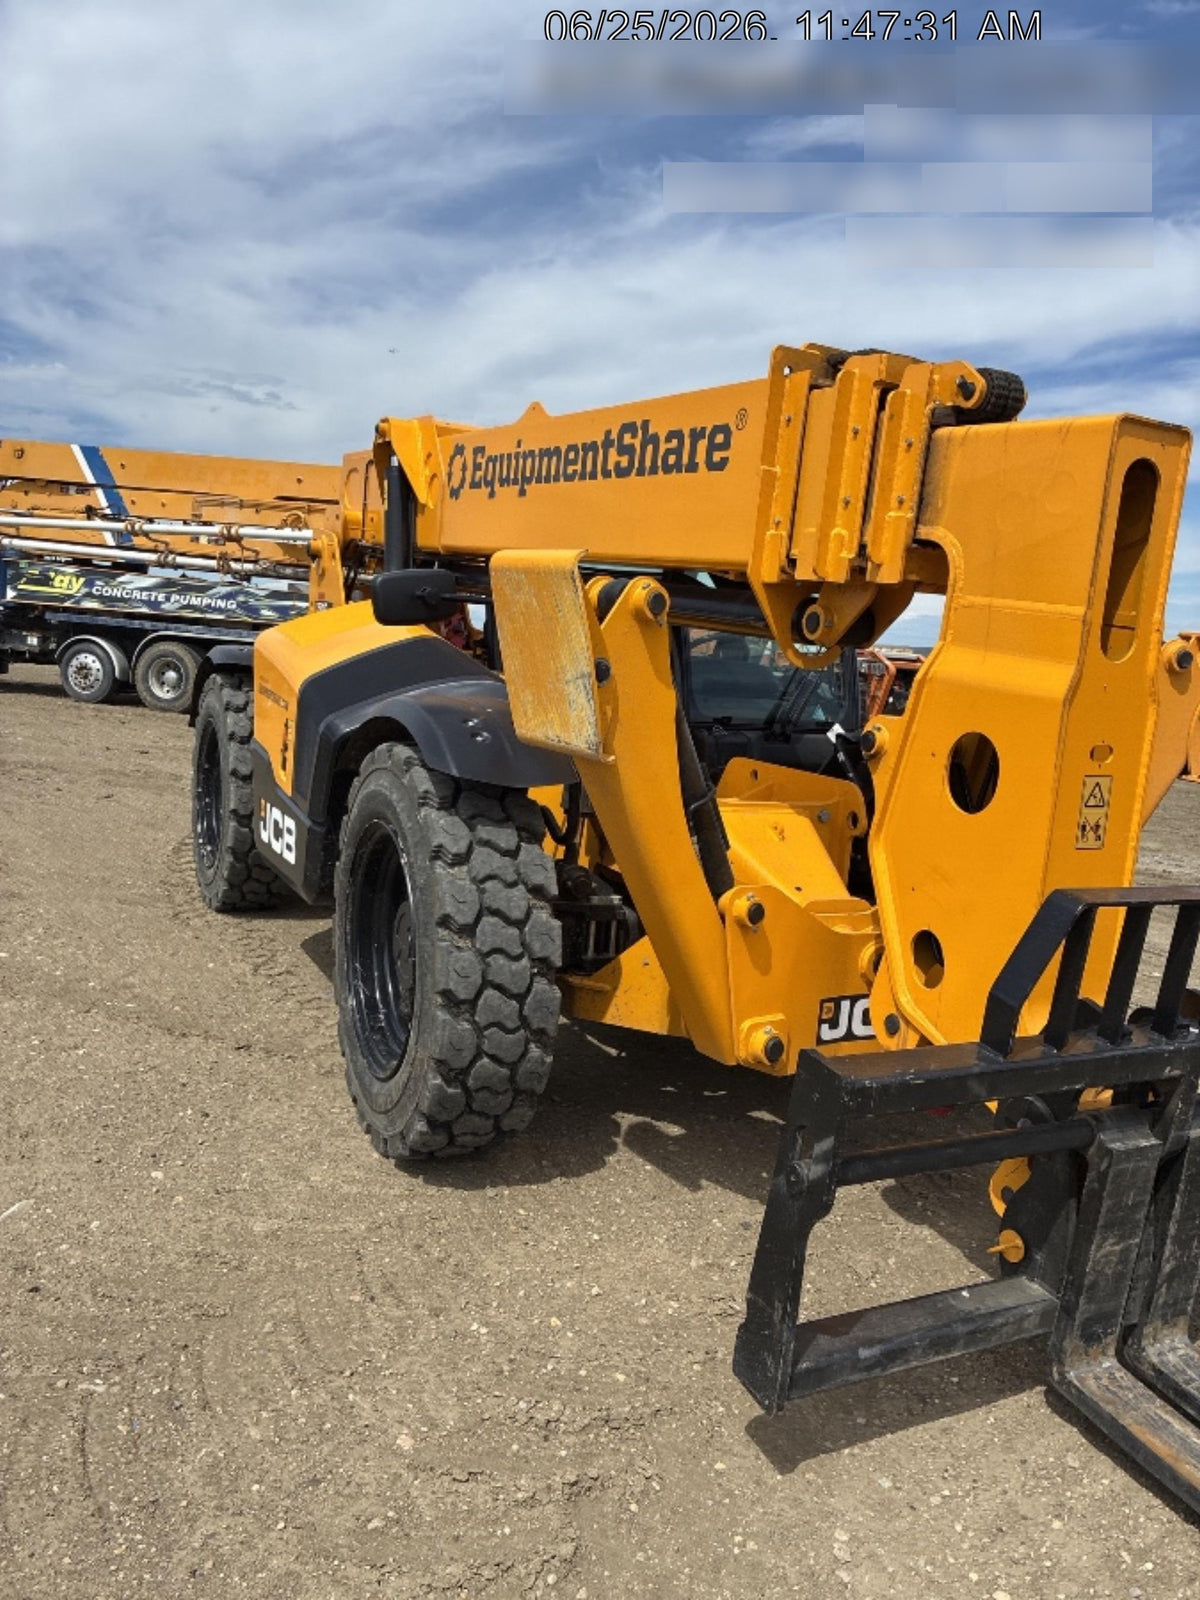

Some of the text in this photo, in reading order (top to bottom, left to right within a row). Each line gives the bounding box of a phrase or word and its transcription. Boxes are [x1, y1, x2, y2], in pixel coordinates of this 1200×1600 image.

[469, 419, 733, 499] EquipmentShare
[91, 586, 237, 609] CONCRETE PUMPING
[260, 802, 297, 865] JCB
[820, 998, 877, 1041] JC
